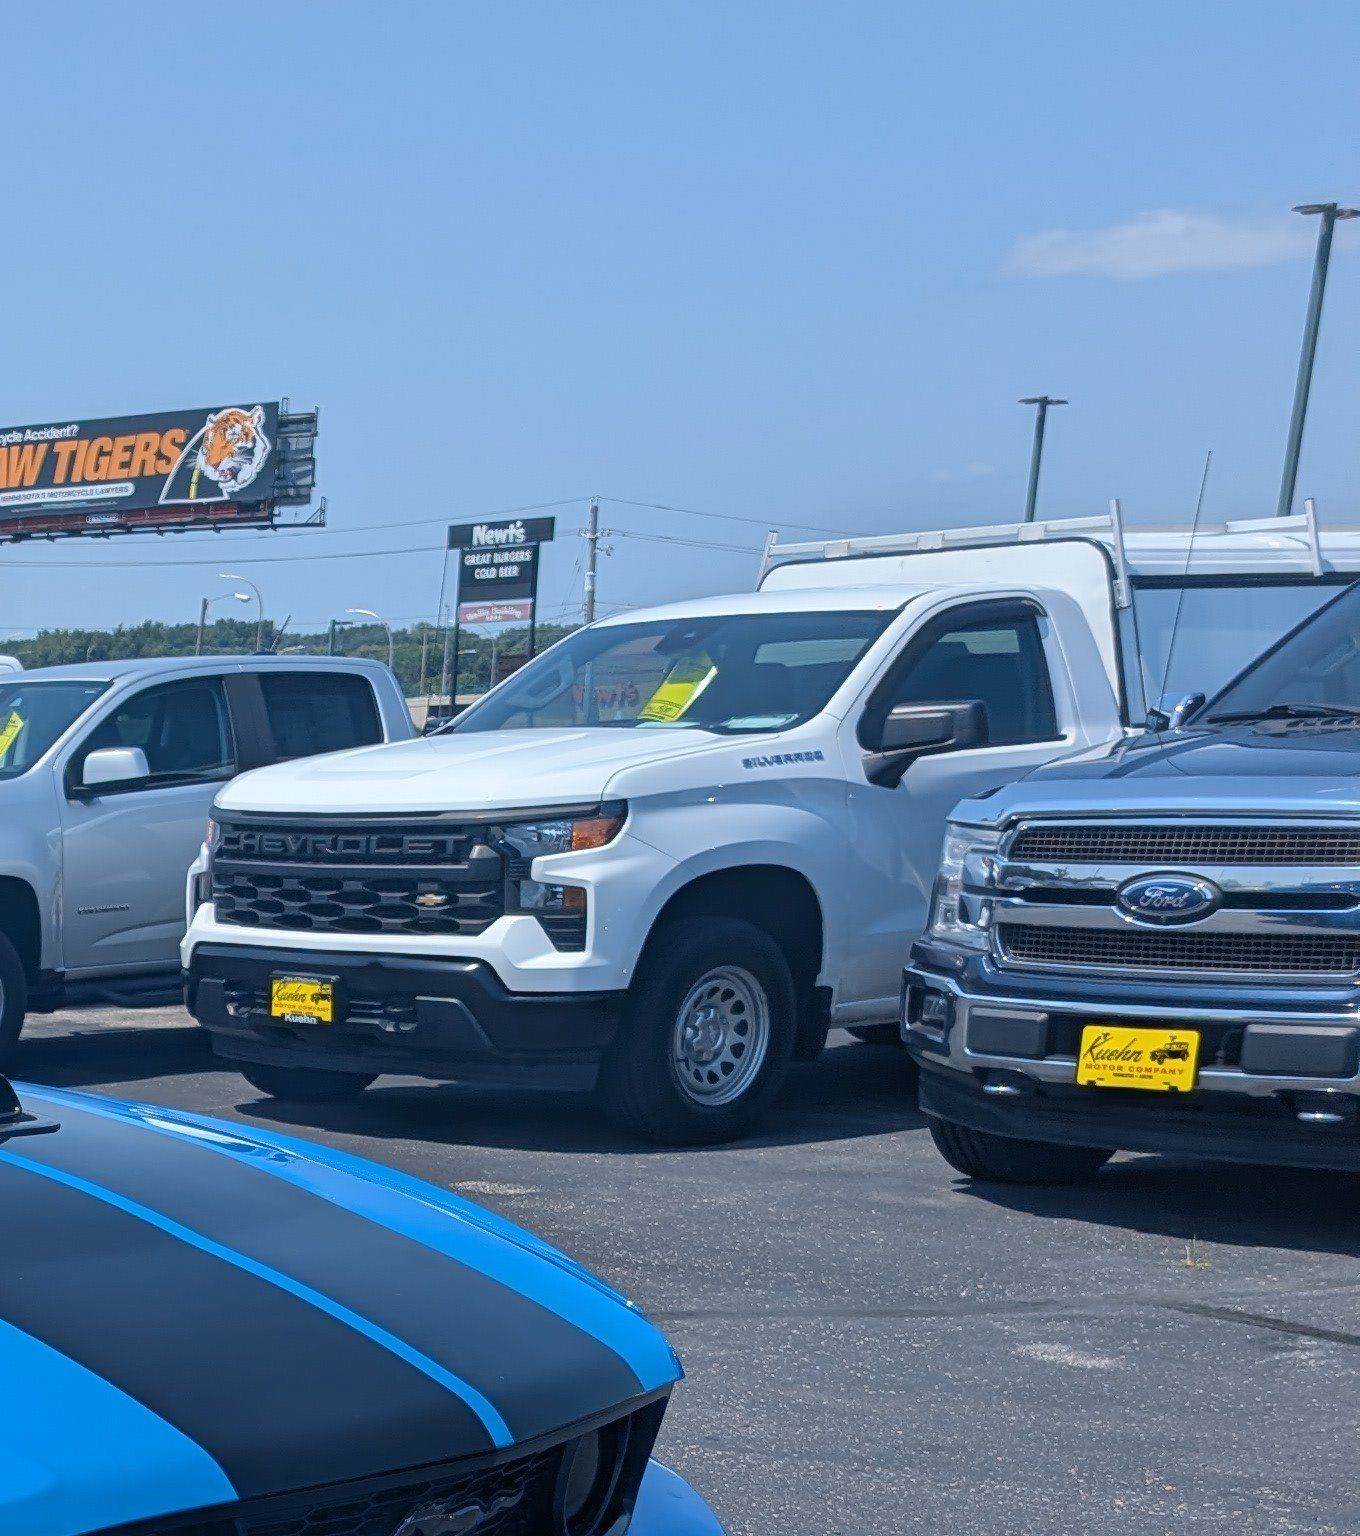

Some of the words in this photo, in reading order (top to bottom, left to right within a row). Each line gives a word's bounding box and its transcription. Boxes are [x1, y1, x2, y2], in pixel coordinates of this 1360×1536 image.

[24, 424, 80, 441] Accident?
[53, 428, 187, 484] TIGERS
[472, 520, 526, 547] Newt's
[221, 831, 468, 856] CHEVROLET
[1139, 885, 1188, 908] Ford
[1083, 1033, 1143, 1063] Kuehn
[1085, 1063, 1123, 1072] MOTOR
[1128, 1065, 1185, 1075] COMPANY
